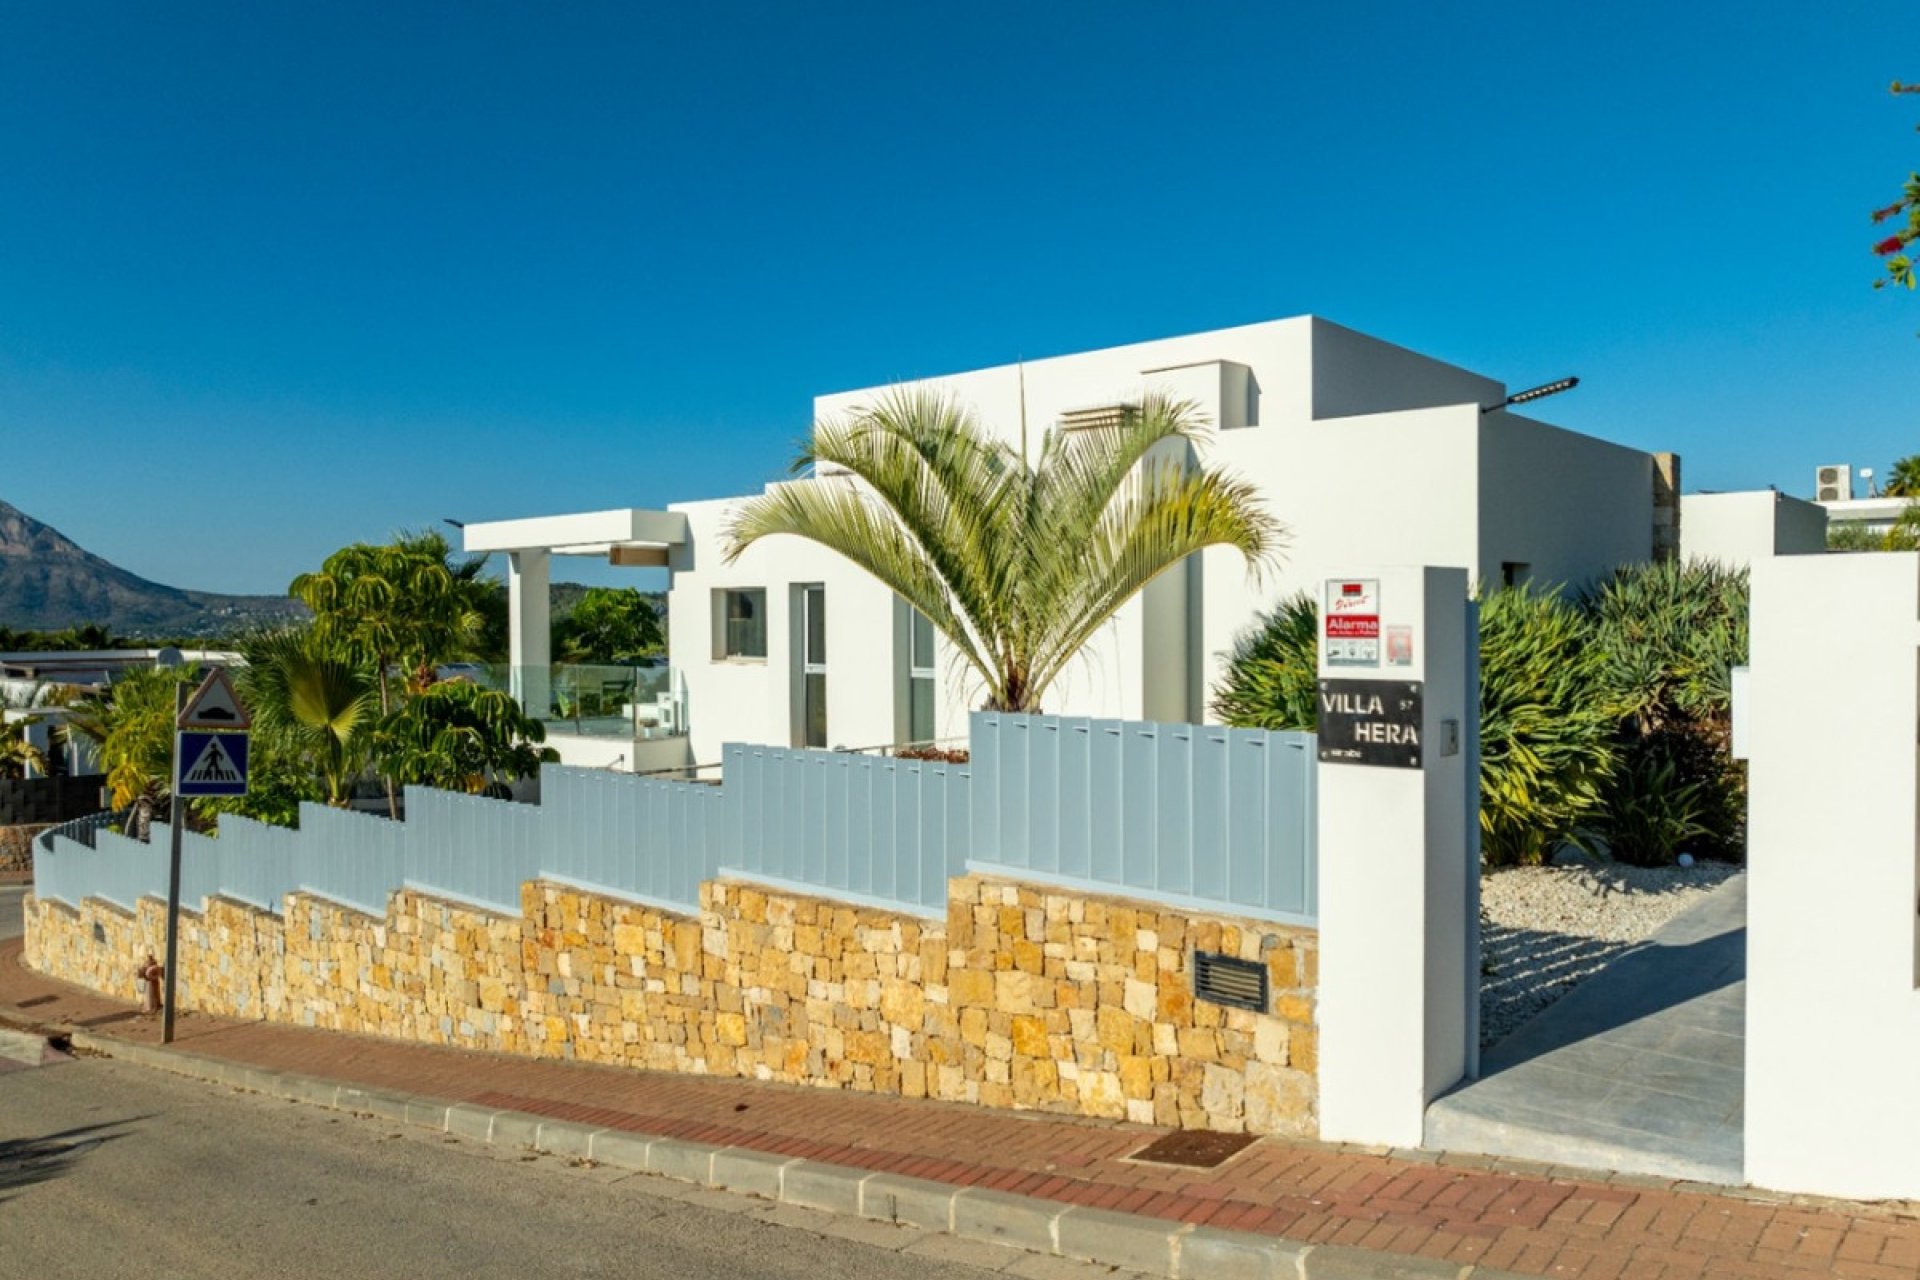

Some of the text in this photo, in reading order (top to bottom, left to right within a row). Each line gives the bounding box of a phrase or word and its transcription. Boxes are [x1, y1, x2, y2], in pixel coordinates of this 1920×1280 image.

[1328, 618, 1377, 631] Alarma
[1322, 694, 1384, 714] VILLA
[1355, 722, 1418, 744] HERA
